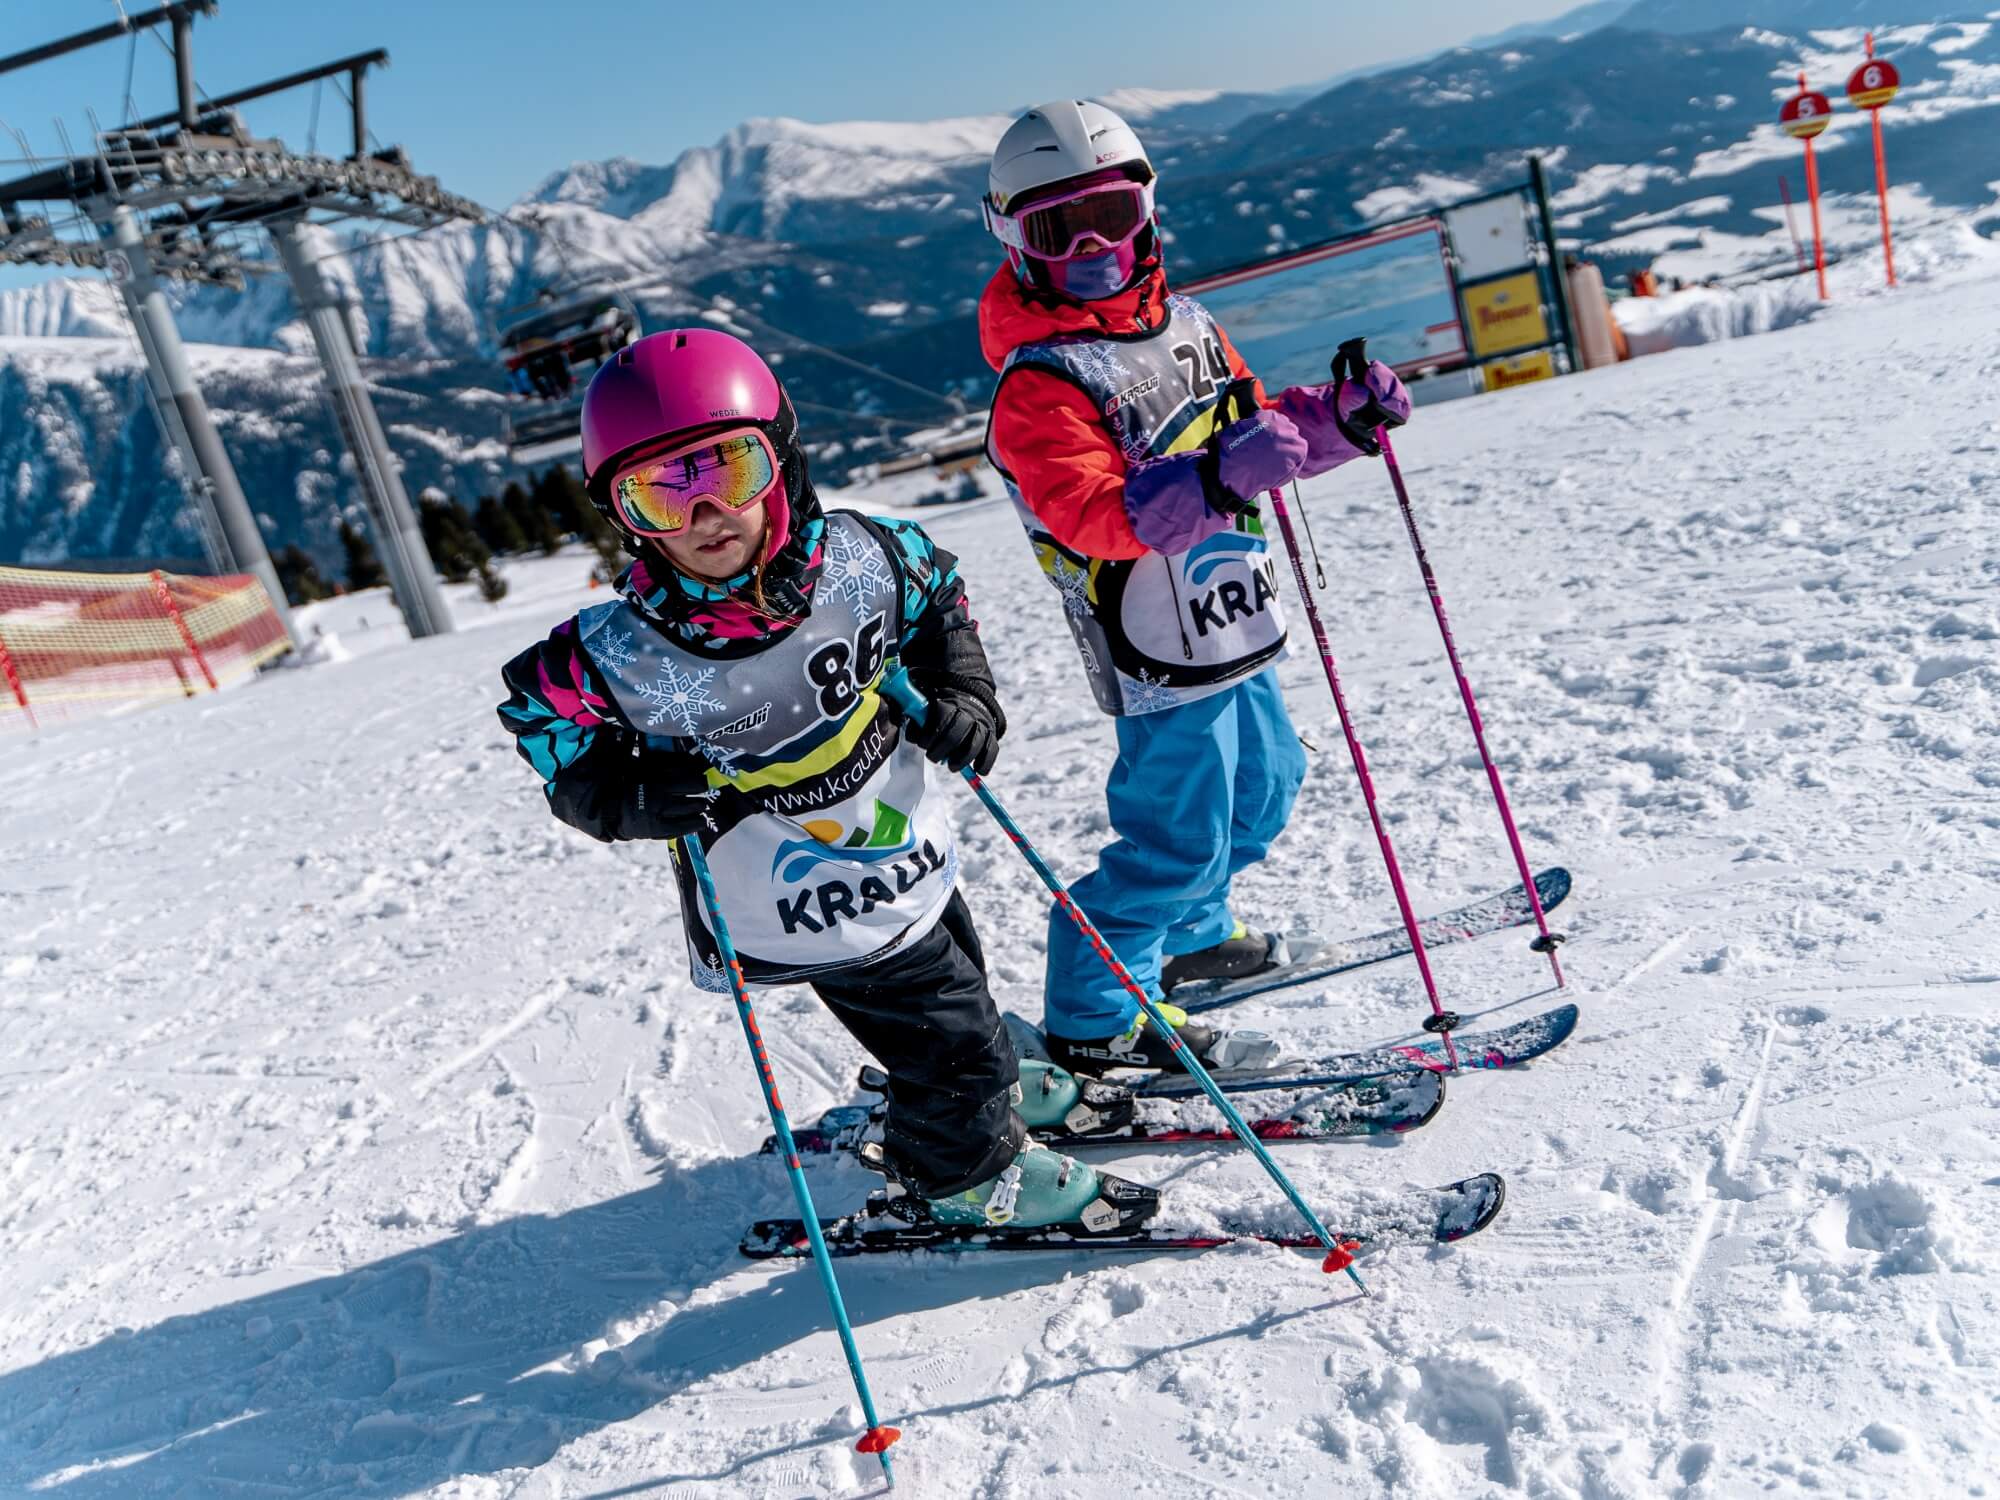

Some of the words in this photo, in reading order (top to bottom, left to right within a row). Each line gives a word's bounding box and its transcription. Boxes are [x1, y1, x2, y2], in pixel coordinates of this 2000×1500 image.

[1863, 65, 1881, 89] 6
[803, 610, 886, 721] 86
[776, 839, 947, 934] KRAUL
[1068, 1045, 1150, 1065] HEAD
[1092, 1214, 1114, 1226] EZY
